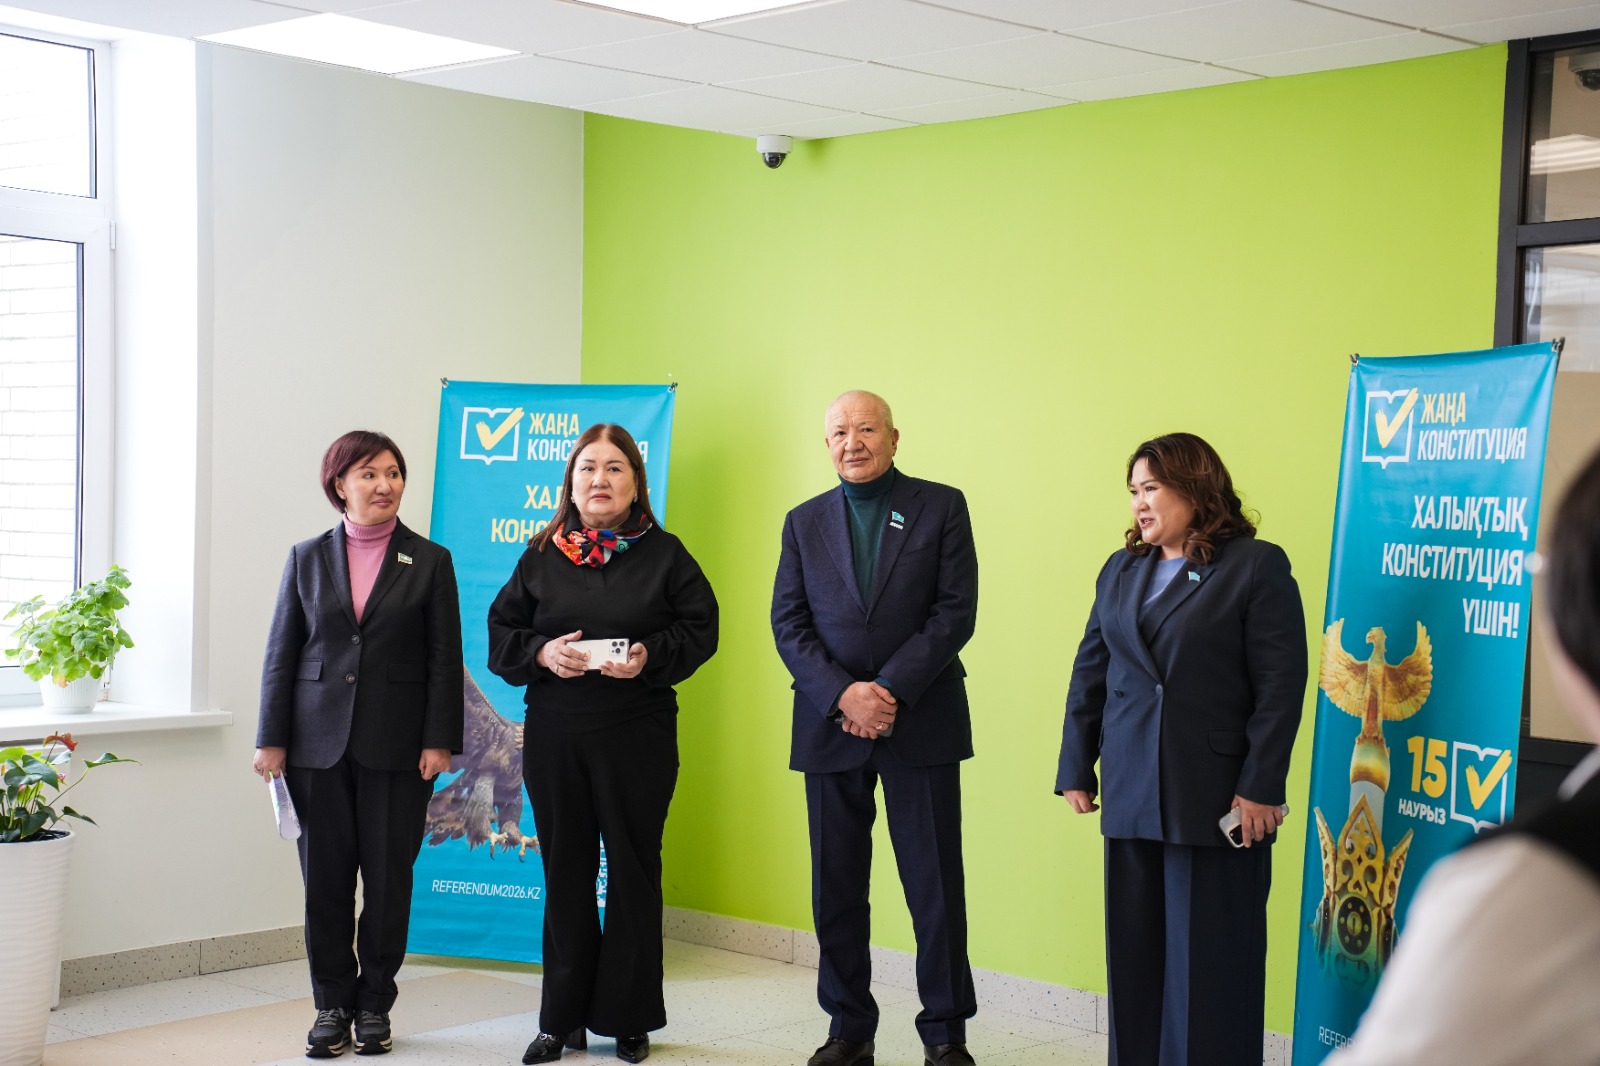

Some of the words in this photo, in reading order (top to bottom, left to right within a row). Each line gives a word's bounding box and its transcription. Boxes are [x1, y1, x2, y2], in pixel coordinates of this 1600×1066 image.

[528, 413, 580, 438] ЖАҢА
[1420, 392, 1466, 426] ЖАҢА
[1417, 427, 1528, 464] КОНСТИТУЦИЯ
[1411, 495, 1529, 541] ХАЛЫҚТЫҚ
[1381, 542, 1524, 591] КОНСТИТУЦИЯ
[1462, 598, 1520, 639] ҮШІН!
[1407, 735, 1448, 798] 15
[1398, 798, 1446, 825] НАУРЫЗ
[431, 879, 541, 900] REFERENDUM2026.KZ
